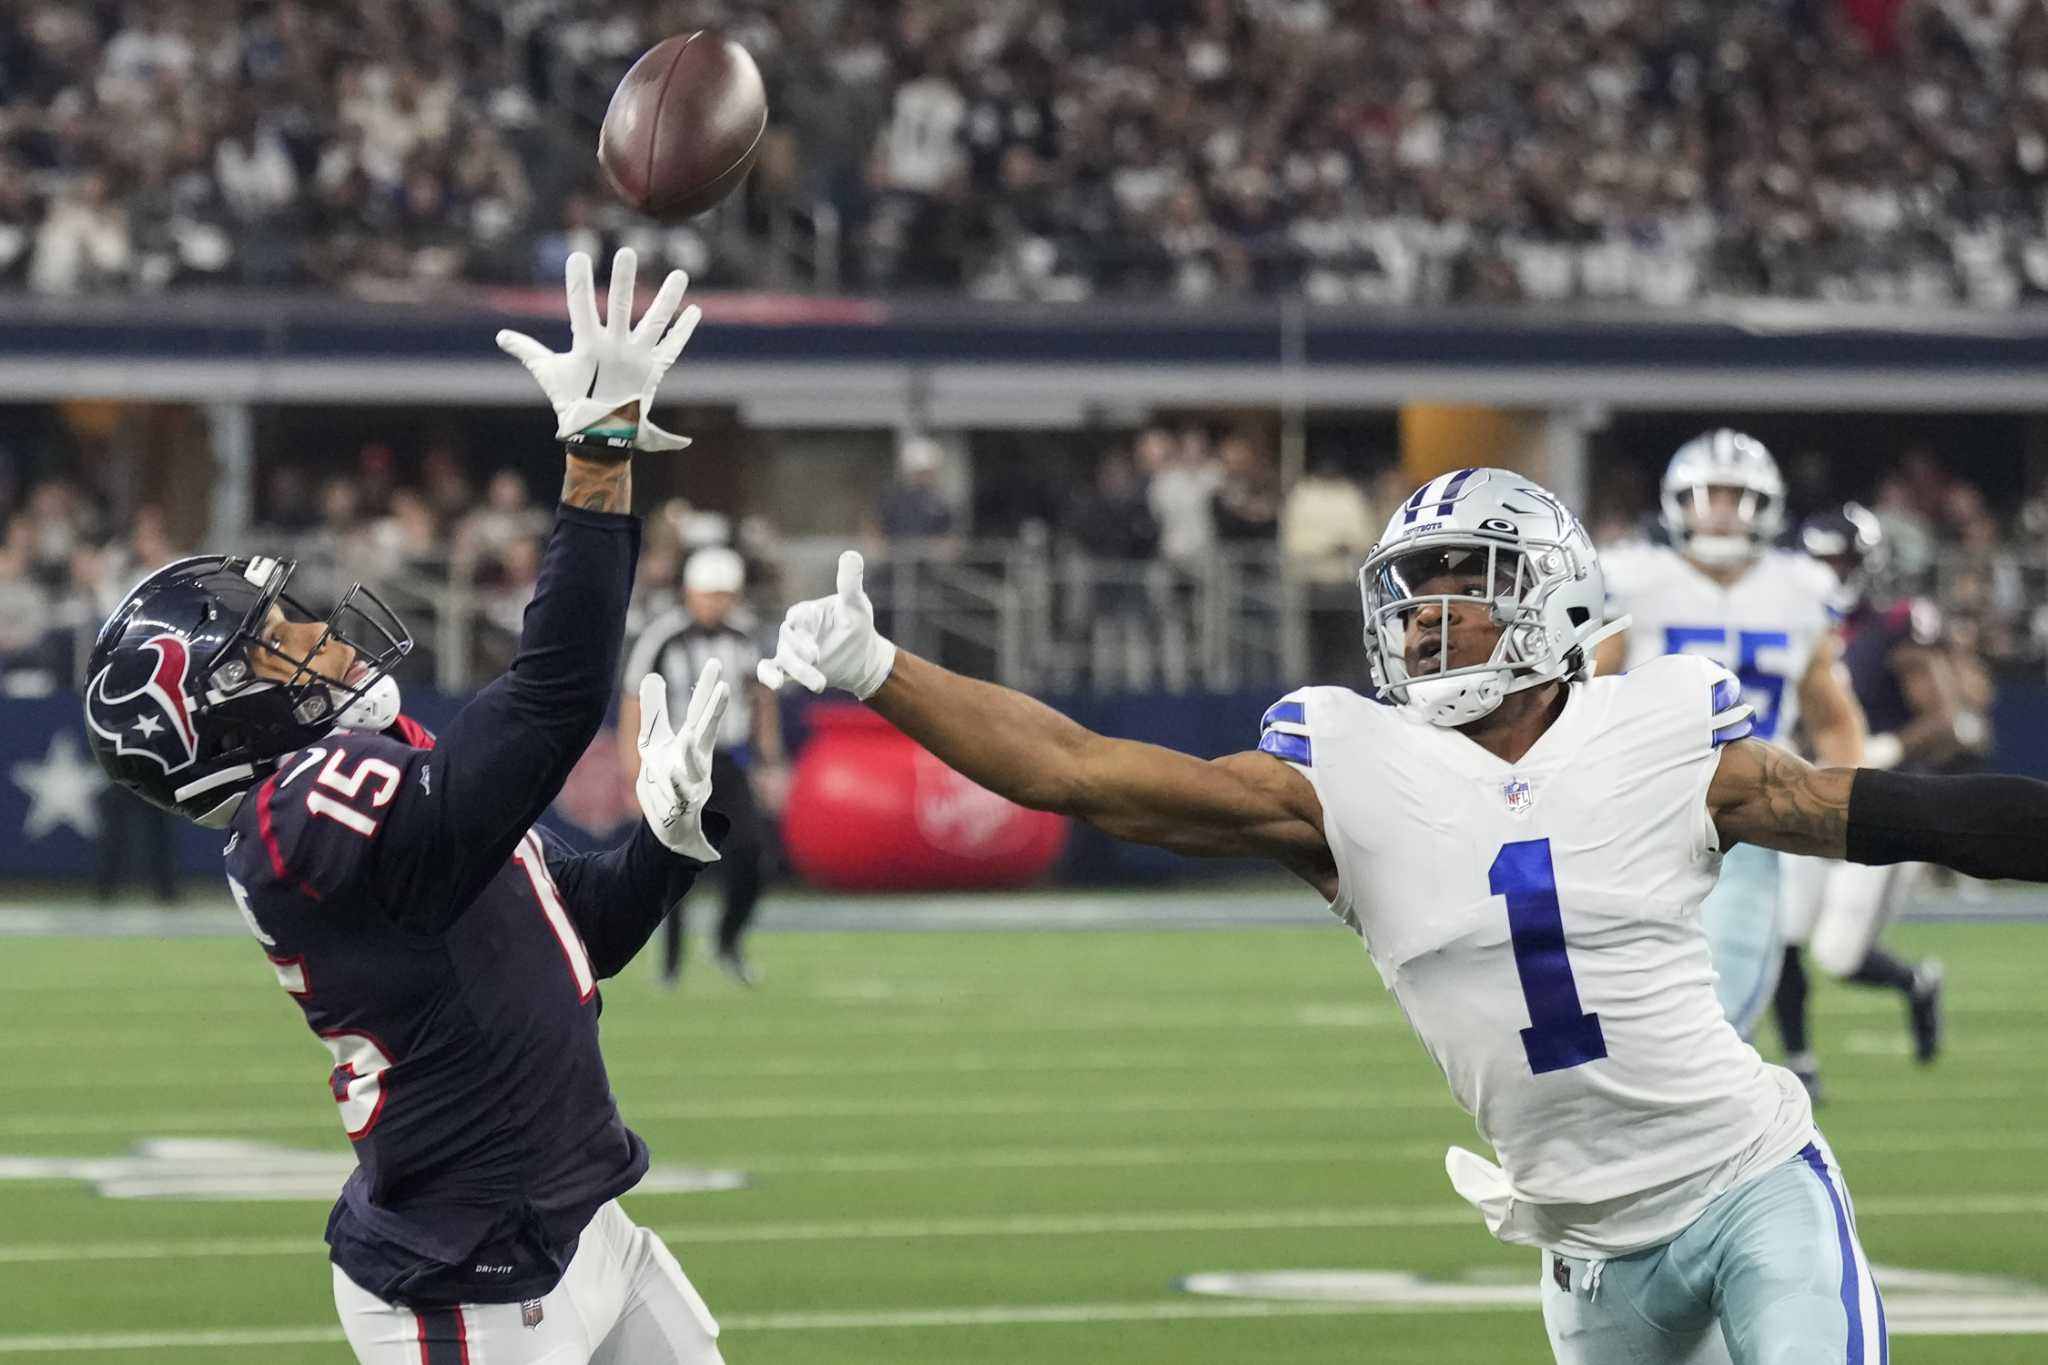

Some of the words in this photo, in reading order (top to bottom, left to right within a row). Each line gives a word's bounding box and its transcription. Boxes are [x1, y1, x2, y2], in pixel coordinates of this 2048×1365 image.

[306, 747, 401, 838] 15
[1488, 837, 1609, 1076] 1
[475, 1264, 513, 1275] DRI-FIT
